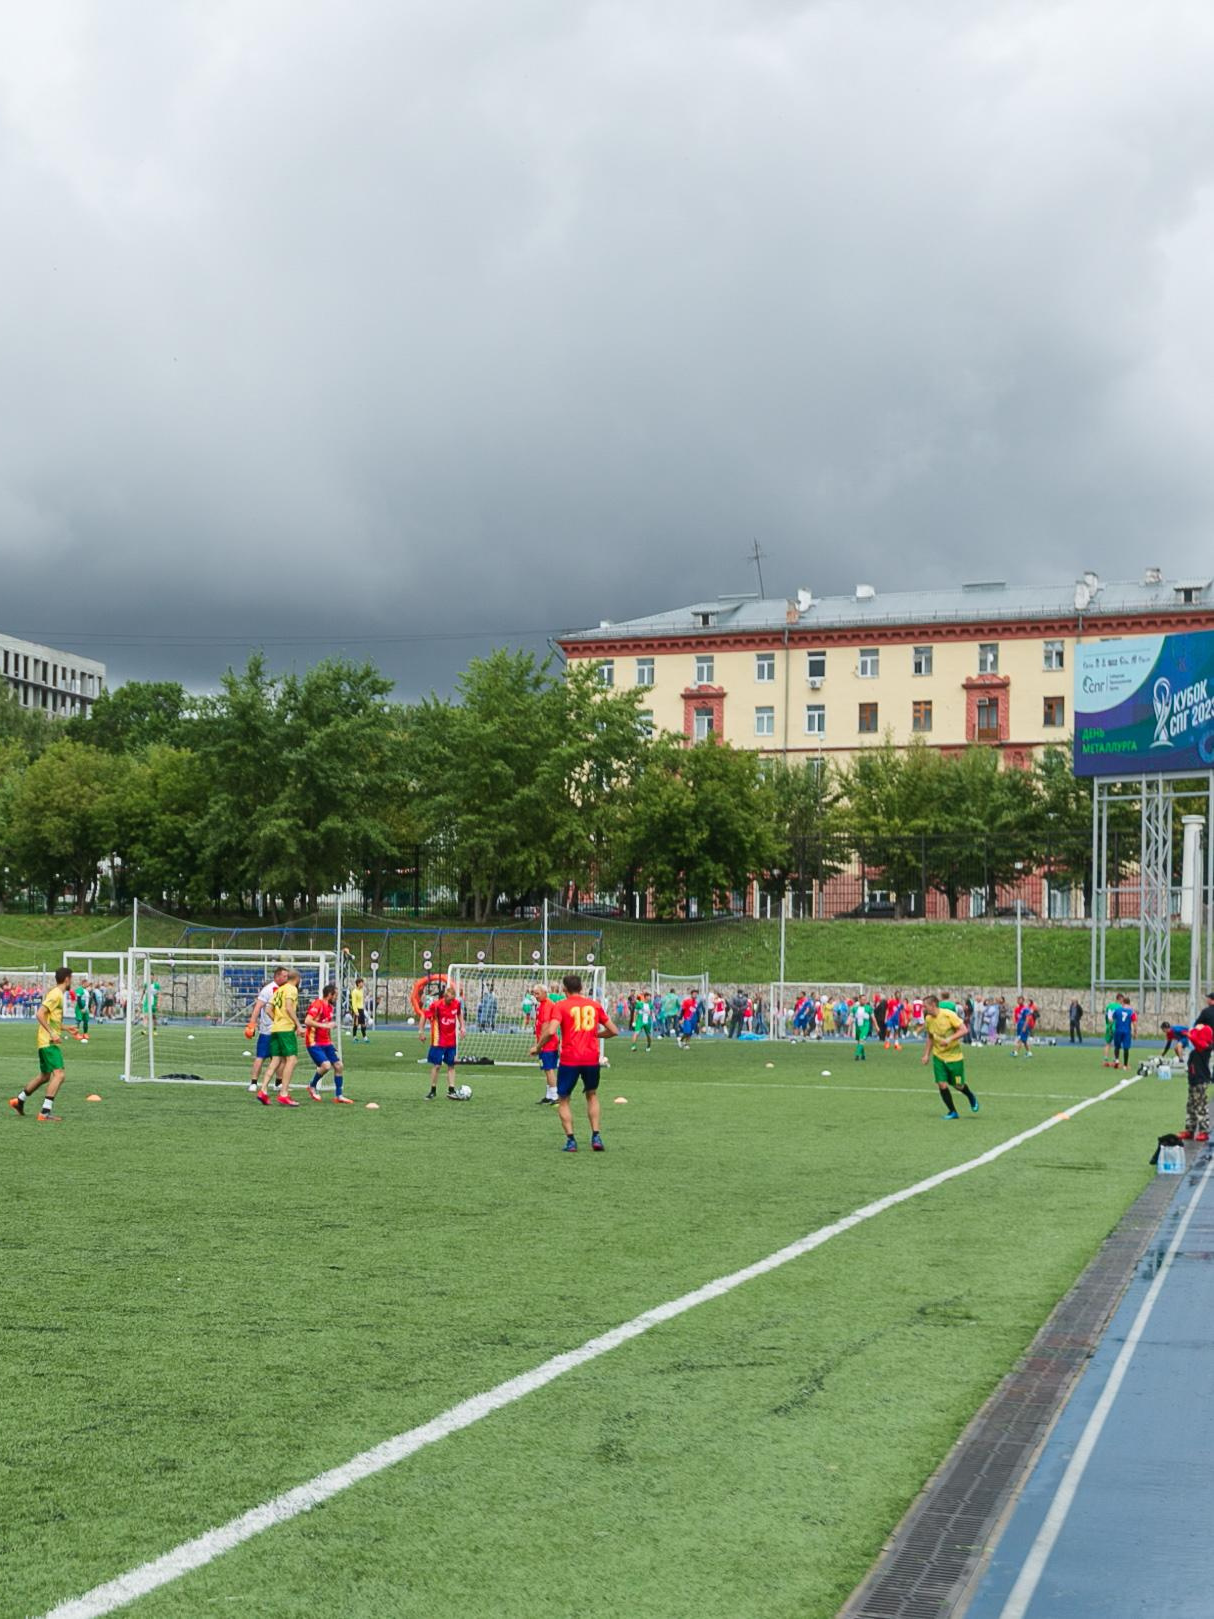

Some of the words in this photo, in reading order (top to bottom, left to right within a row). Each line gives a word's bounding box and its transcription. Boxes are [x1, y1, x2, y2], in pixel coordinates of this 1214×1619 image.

[1173, 678, 1208, 714] КУБОК
[1170, 710, 1190, 736] СПГ
[570, 1005, 596, 1032] 18
[1122, 1011, 1128, 1022] 7
